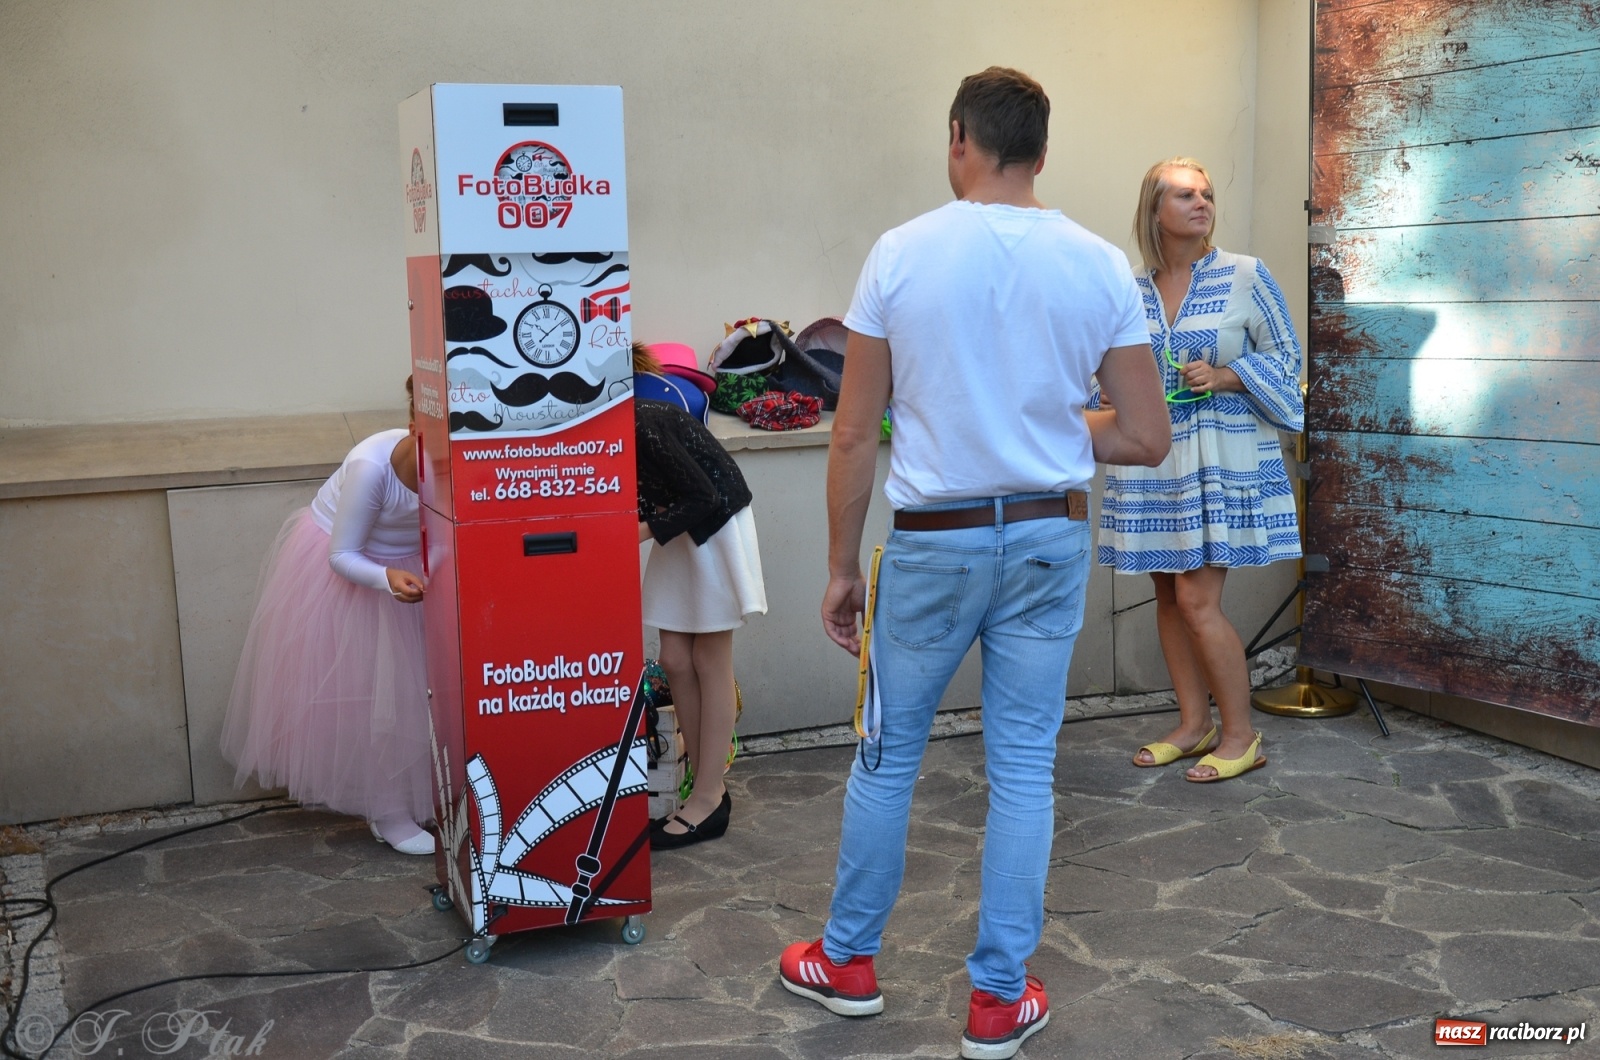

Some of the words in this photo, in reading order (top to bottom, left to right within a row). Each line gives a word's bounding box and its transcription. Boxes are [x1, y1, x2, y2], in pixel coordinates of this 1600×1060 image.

[457, 174, 611, 196] FotoBudka
[497, 201, 573, 229] 007
[443, 277, 539, 299] oustache
[588, 324, 632, 348] Retr
[448, 381, 491, 403] etro
[463, 439, 623, 460] www.fotobudka007.pl
[495, 465, 558, 481] Wynajmij
[562, 463, 595, 476] mnie
[470, 488, 491, 501] tel.
[495, 476, 621, 500] 668-832-564
[483, 655, 583, 686] FotoBudka
[587, 652, 624, 676] 007
[478, 697, 503, 715] na
[508, 685, 566, 713] każdą
[570, 679, 631, 708] okazje
